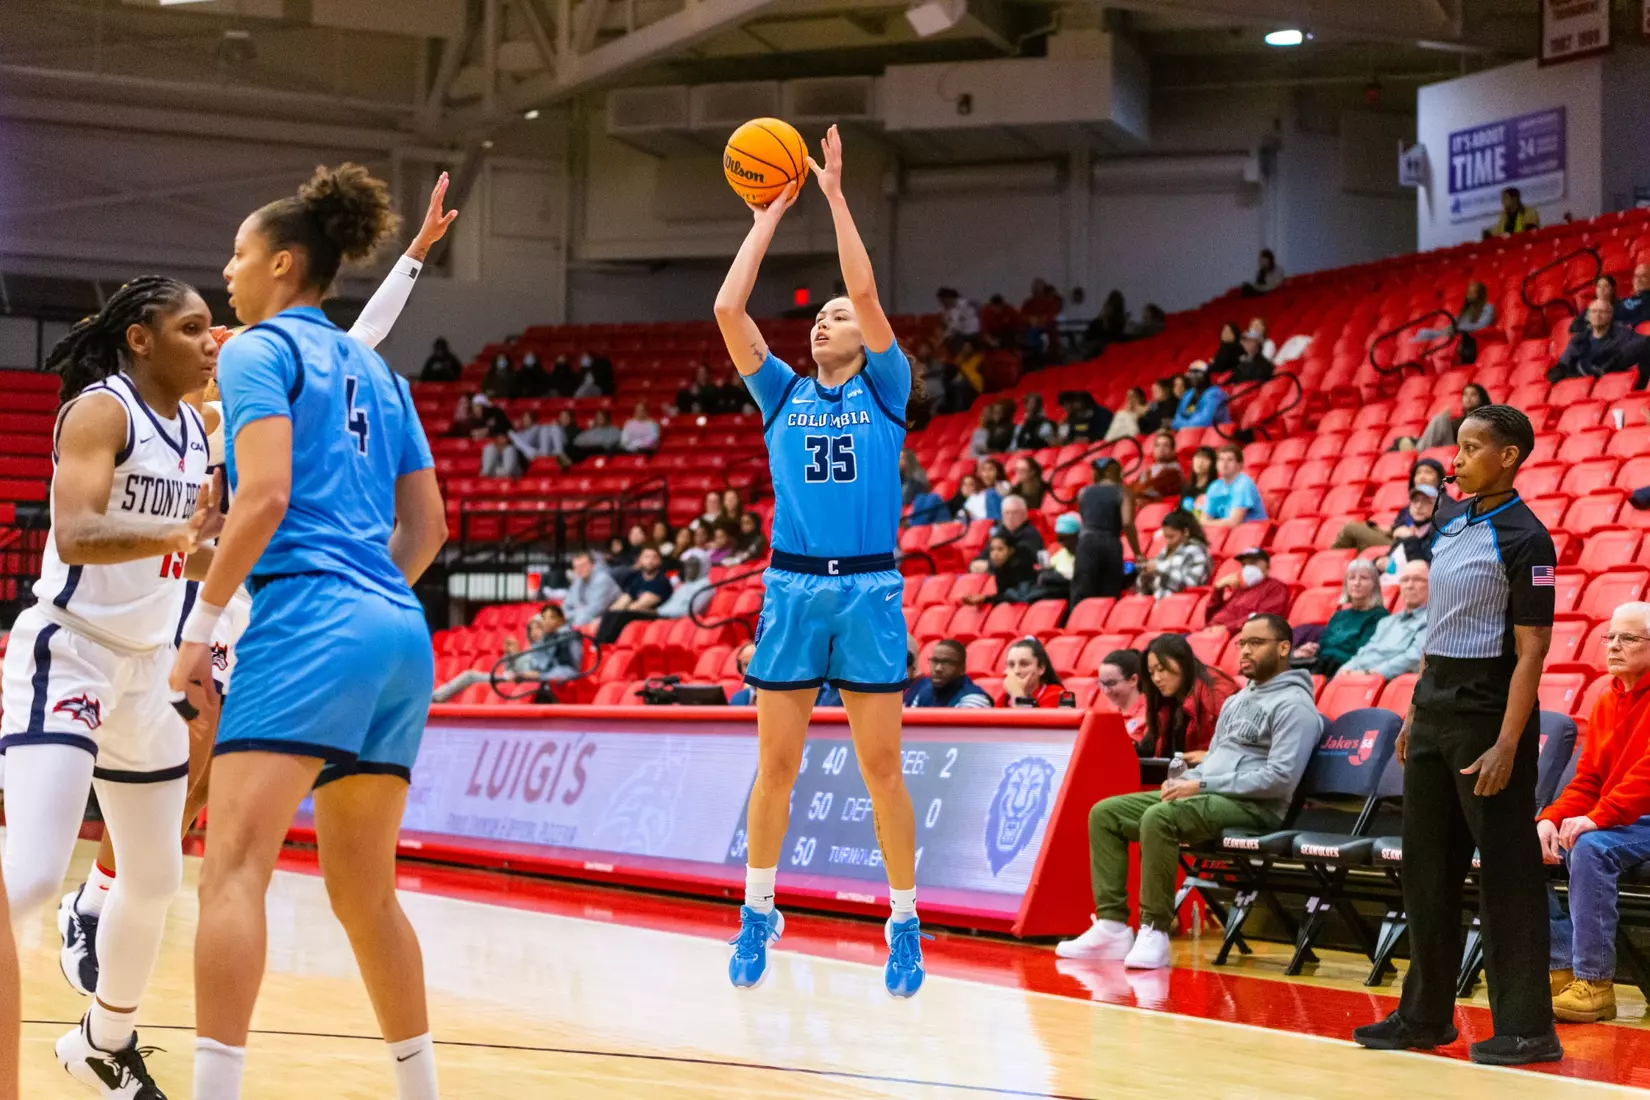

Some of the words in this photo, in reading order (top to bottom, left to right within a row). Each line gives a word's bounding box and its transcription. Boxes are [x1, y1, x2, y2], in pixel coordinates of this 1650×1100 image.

[725, 152, 764, 184] Wilson
[1452, 146, 1506, 190] TIME
[344, 374, 370, 457] 4
[787, 410, 870, 429] COLUMBIA
[804, 433, 858, 484] 35
[121, 473, 183, 519] STONY
[828, 559, 839, 575] C
[822, 746, 848, 776] 40
[939, 748, 958, 778] 2
[808, 791, 833, 821] 50
[924, 798, 942, 828] 0
[791, 836, 817, 866] 50
[1222, 837, 1259, 850] SEAWOLVES
[1300, 843, 1340, 858] SEAWOLVES
